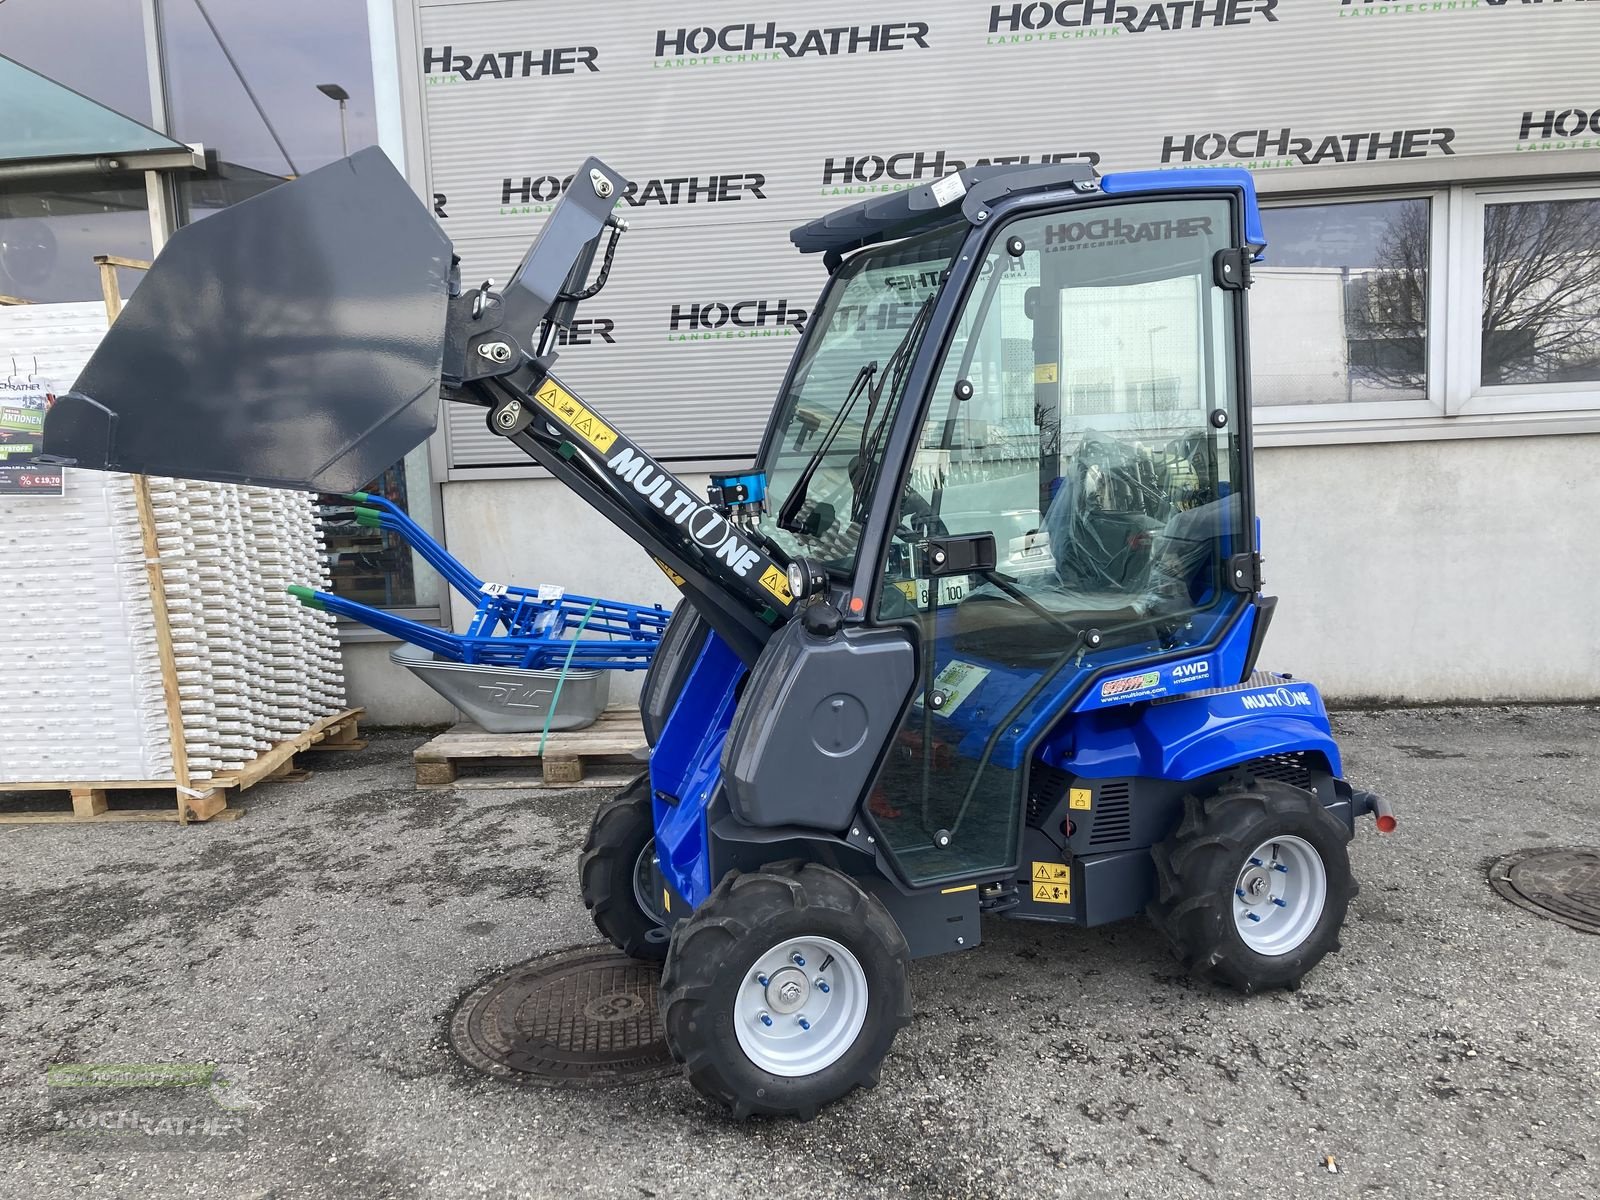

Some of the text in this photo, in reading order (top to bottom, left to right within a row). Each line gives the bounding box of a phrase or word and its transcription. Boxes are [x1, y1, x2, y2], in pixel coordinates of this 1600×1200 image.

[988, 0, 1279, 33] HOCHRATHER
[655, 21, 930, 58] HOCHRATHER
[987, 26, 1121, 45] LANDTECHNIK
[654, 51, 782, 68] LANDTECHNIK
[1160, 128, 1456, 164] HOCHRATHER
[502, 173, 767, 206] HORATHER
[1045, 216, 1214, 245] HOCHRATHER
[668, 328, 792, 342] LANDTECHNIK
[489, 583, 503, 594] AT
[946, 585, 963, 601] 100
[1172, 661, 1209, 677] 4WD
[1100, 687, 1167, 703] www.multione.com
